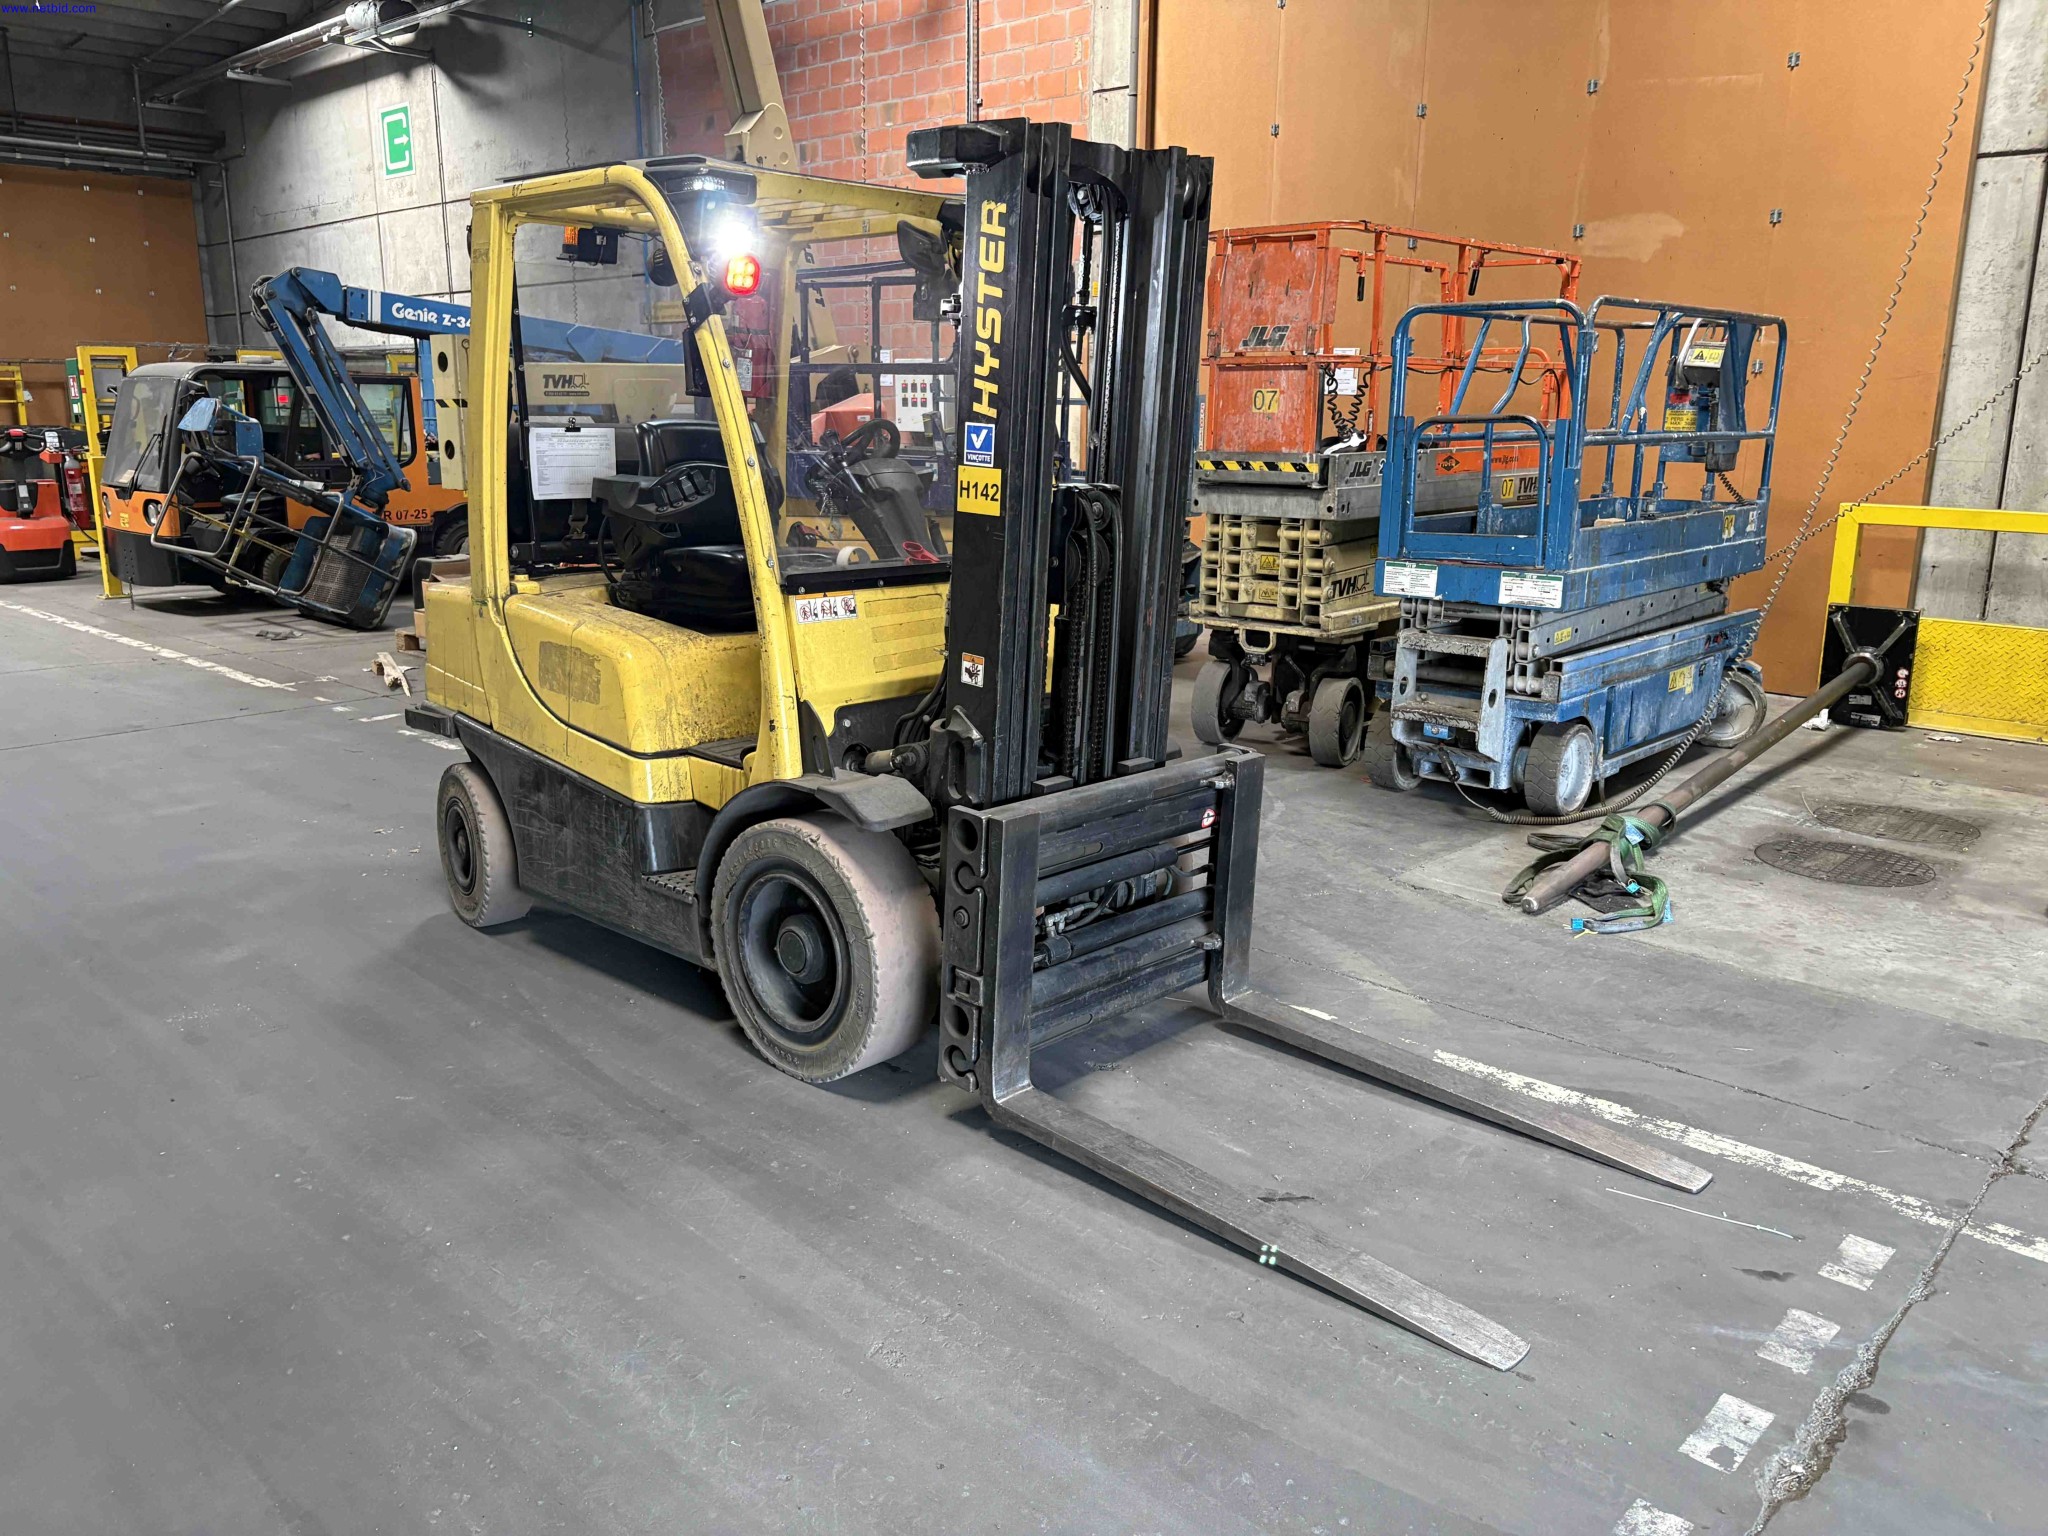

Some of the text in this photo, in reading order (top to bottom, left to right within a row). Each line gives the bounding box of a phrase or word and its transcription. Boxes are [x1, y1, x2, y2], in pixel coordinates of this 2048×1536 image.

[391, 302, 438, 324] Genie
[972, 199, 1007, 419] HYSTER
[1240, 325, 1291, 348] JLG
[542, 374, 573, 389] TVH
[1253, 389, 1278, 411] 07
[967, 453, 991, 463] VINÇOTTE
[1349, 460, 1373, 478] JLG
[959, 479, 1000, 502] H142
[1501, 478, 1514, 497] 07
[1517, 476, 1538, 494] TVH
[384, 509, 428, 520] R 07-25
[1331, 575, 1358, 599] TVH
